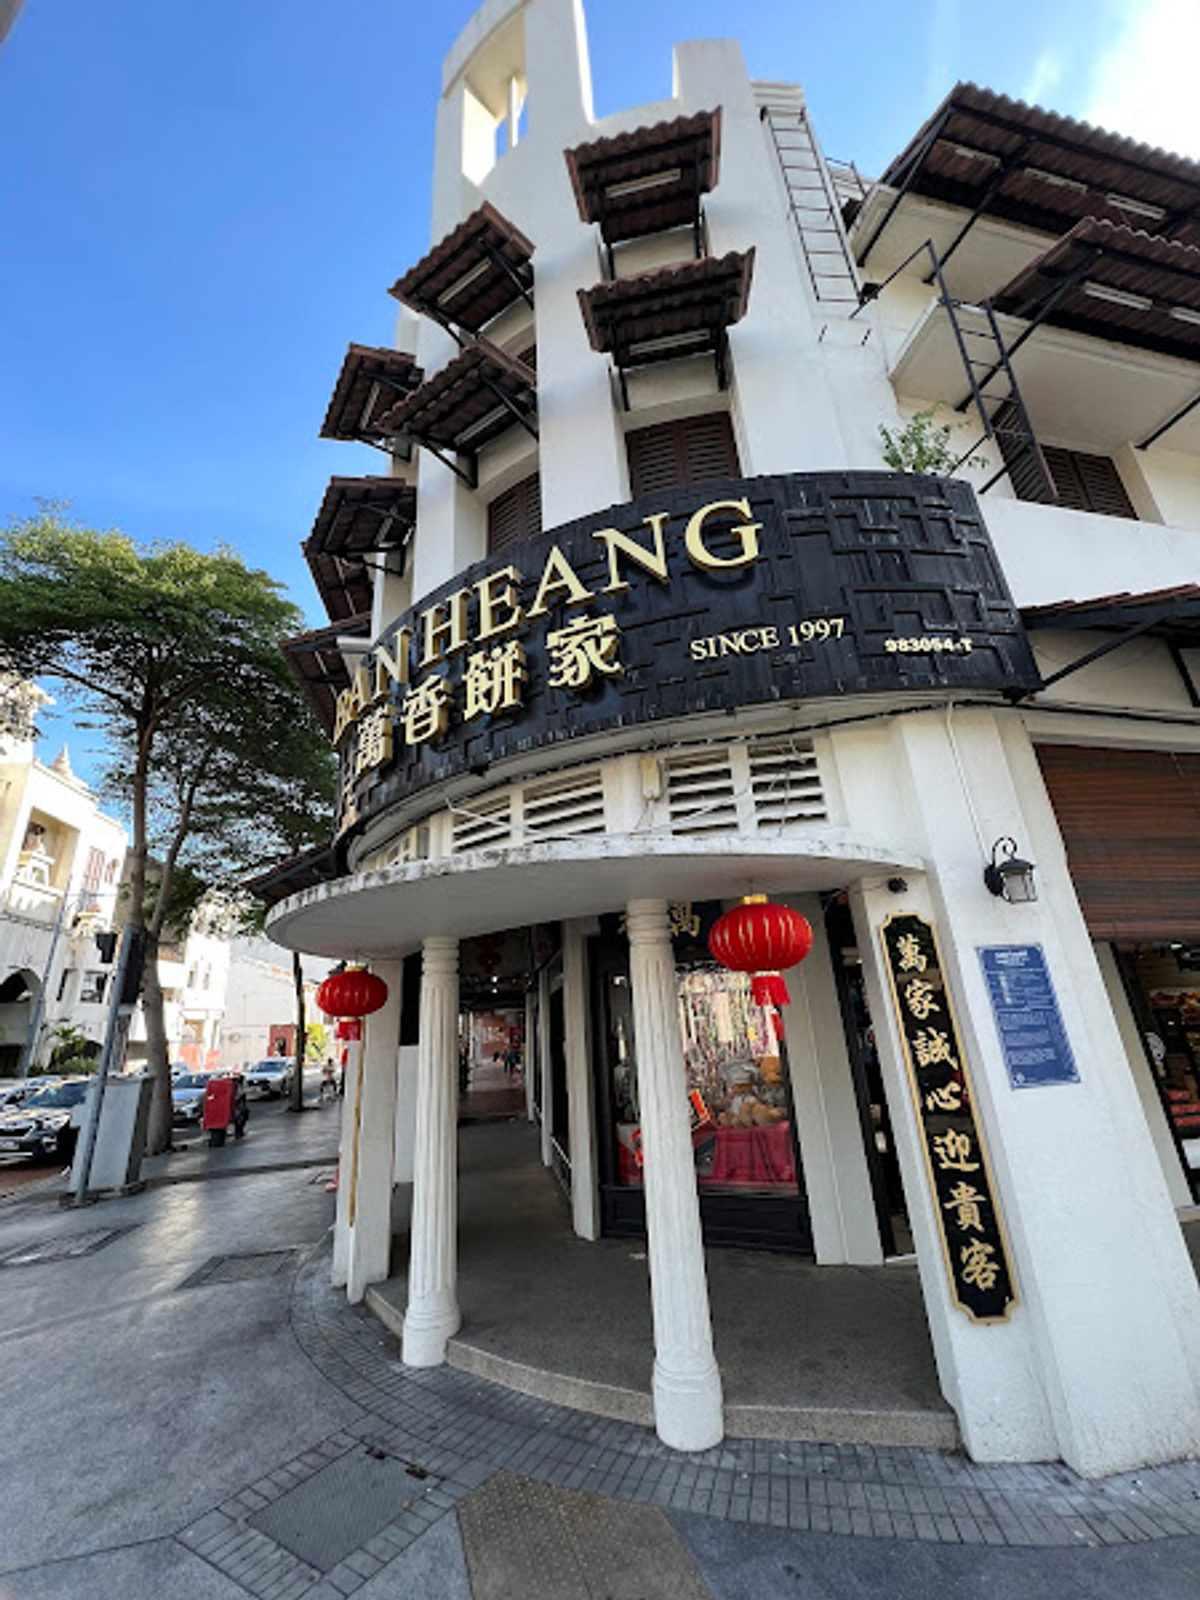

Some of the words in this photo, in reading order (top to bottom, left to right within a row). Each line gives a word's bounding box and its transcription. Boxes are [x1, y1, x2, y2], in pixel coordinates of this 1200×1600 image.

[418, 497, 764, 670] HEANG
[690, 627, 779, 661] SINCE
[787, 618, 845, 647] 1997
[355, 613, 624, 774] 萬香餅家
[896, 933, 1001, 1291] 萬家誠心迎貴客
